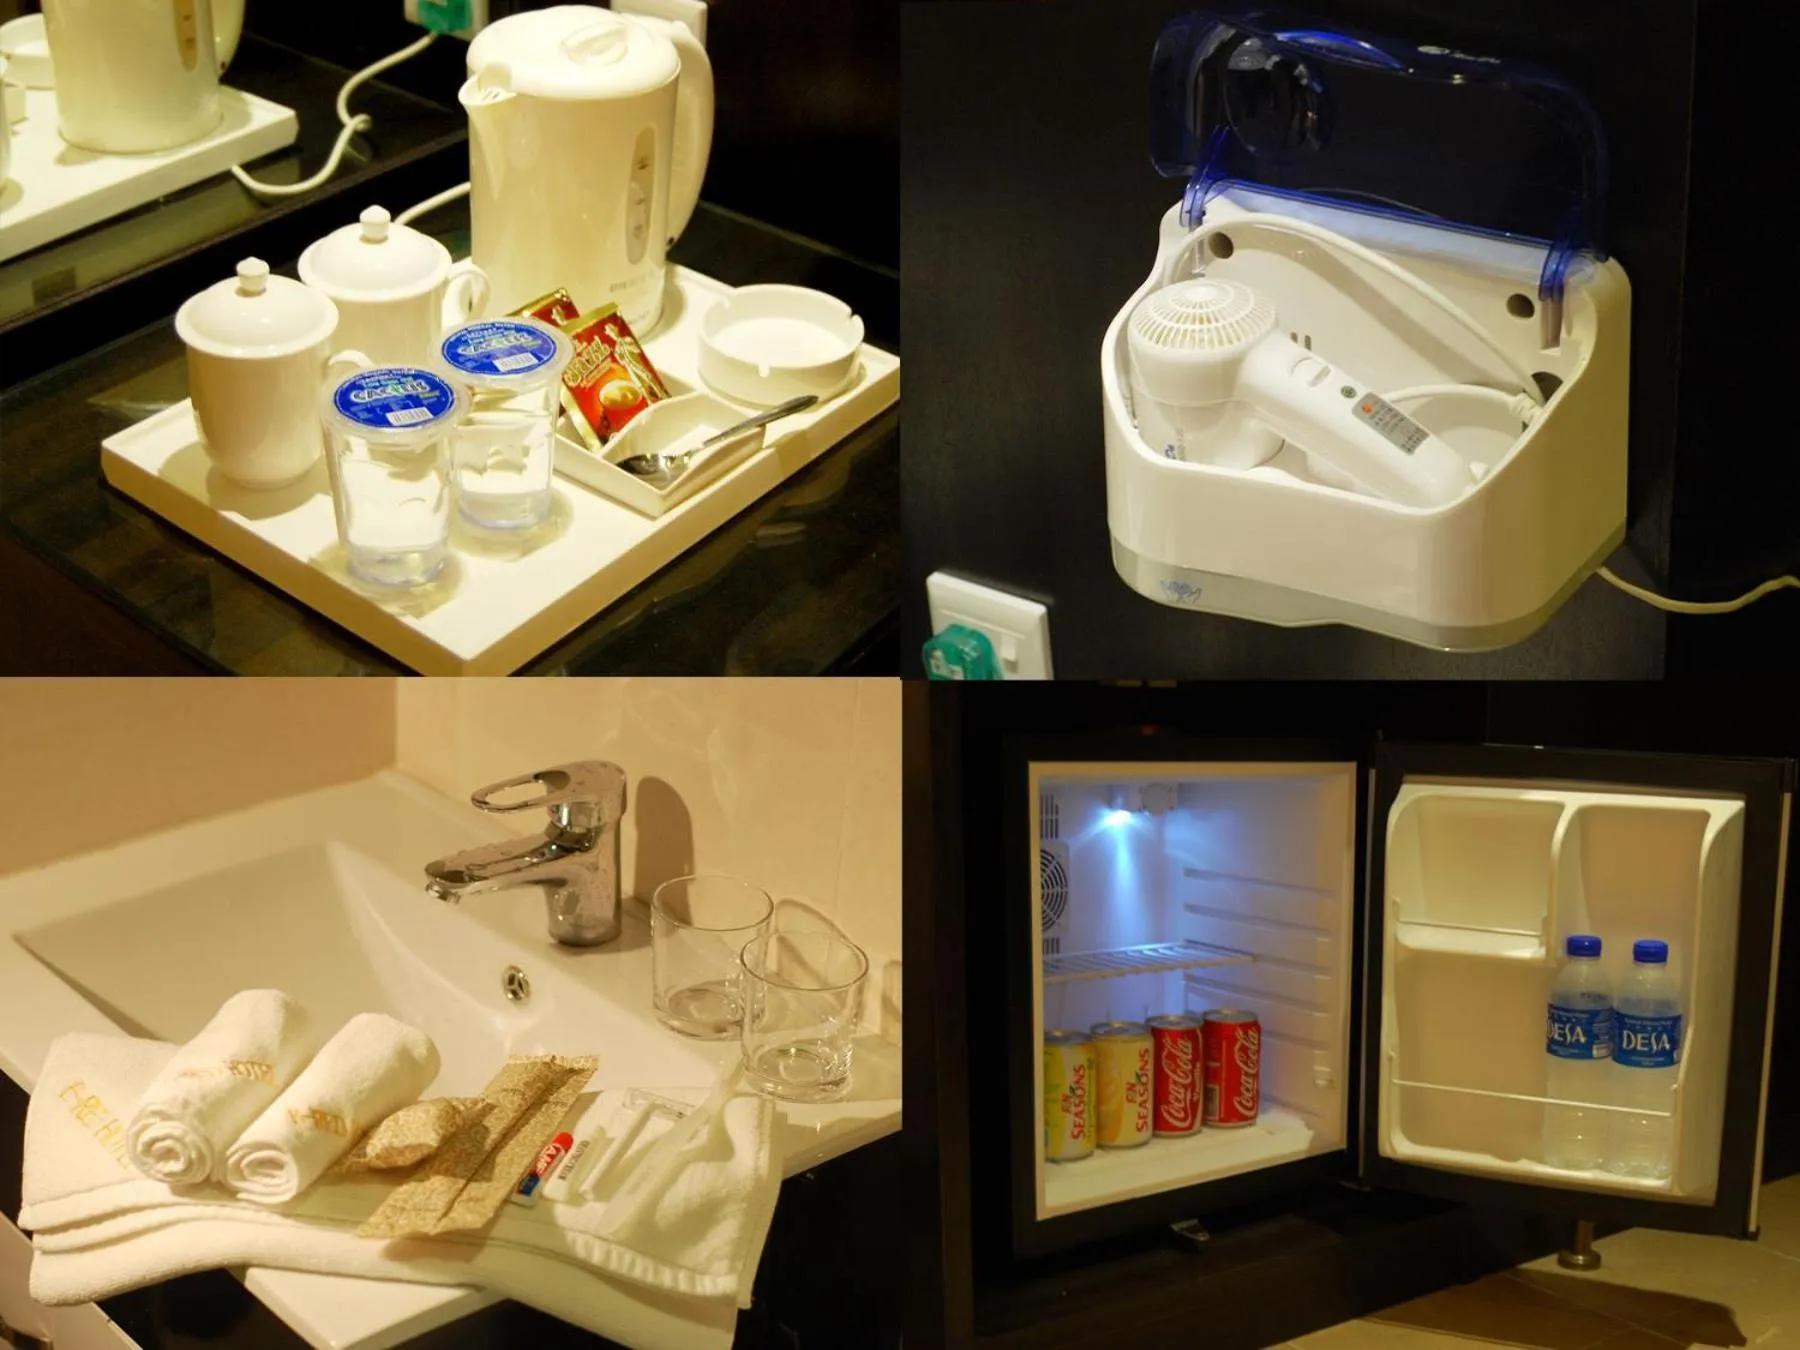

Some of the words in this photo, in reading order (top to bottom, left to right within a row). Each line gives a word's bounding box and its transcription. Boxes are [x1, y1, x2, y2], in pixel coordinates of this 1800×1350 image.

[1623, 1030, 1670, 1054] DESA
[1072, 1064, 1085, 1139] SEASONS
[1136, 1048, 1149, 1133] SEASONS
